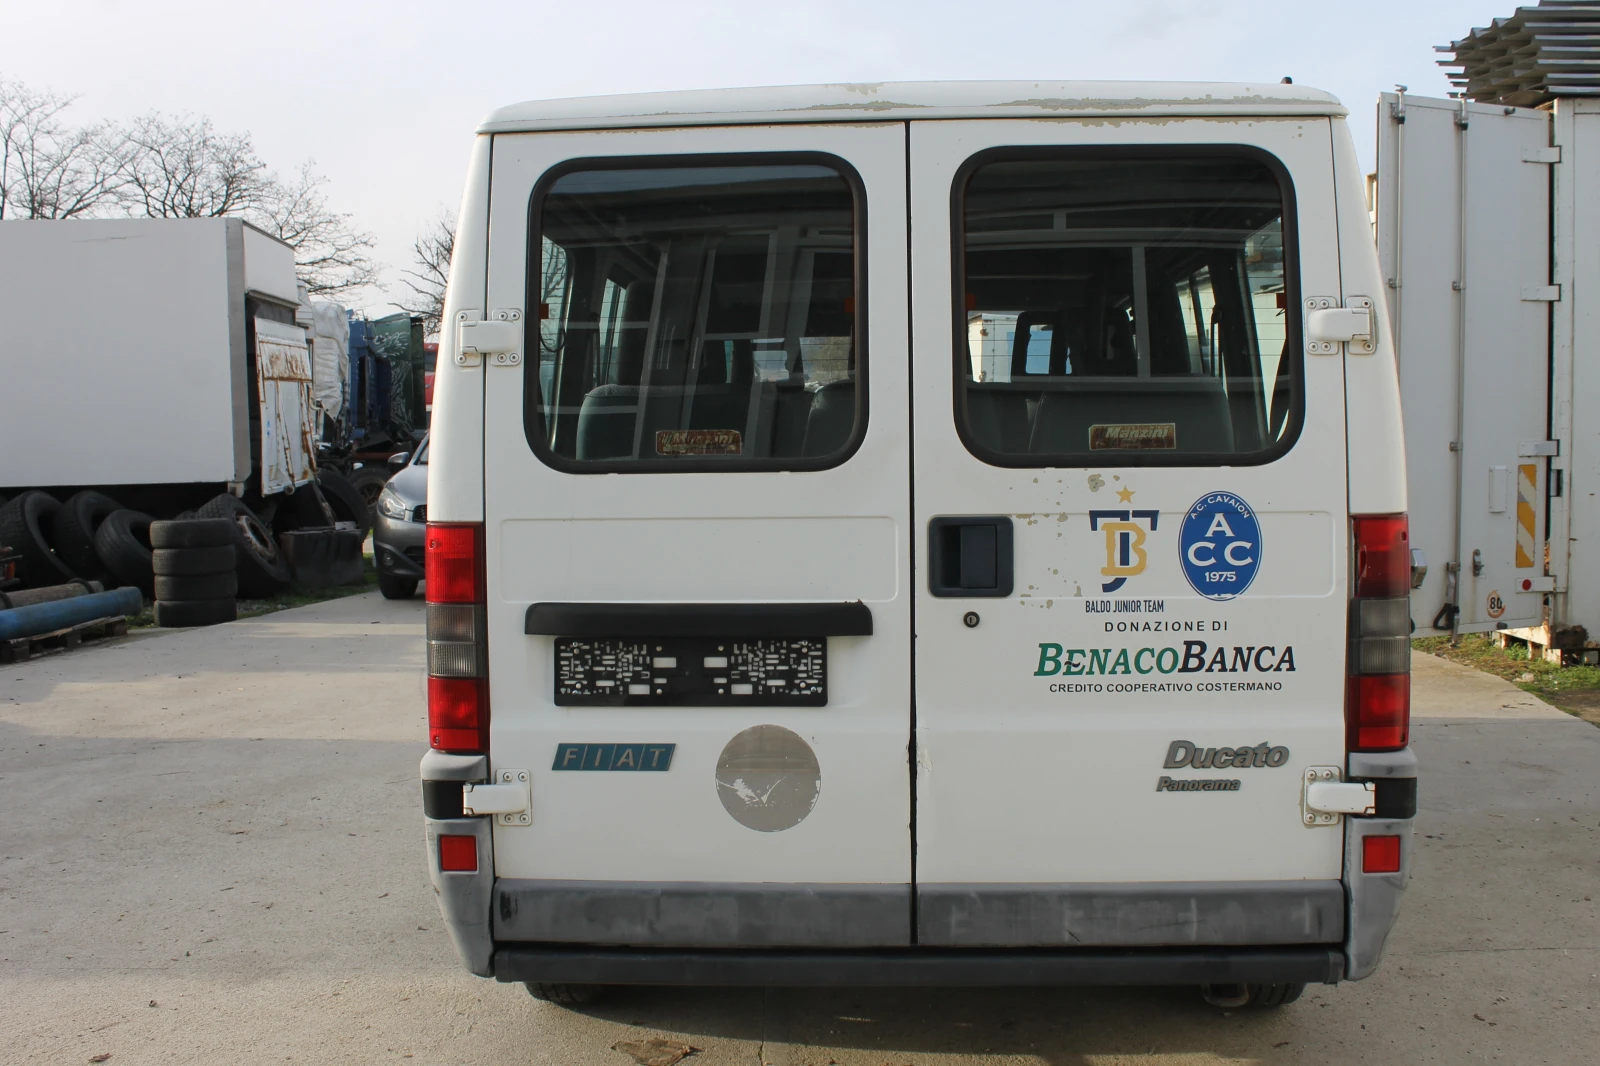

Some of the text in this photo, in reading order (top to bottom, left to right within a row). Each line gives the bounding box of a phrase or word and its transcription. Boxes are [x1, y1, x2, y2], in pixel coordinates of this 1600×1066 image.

[1105, 426, 1169, 438] Manzini
[1190, 495, 1250, 520] A.C. CAVAION
[1204, 571, 1237, 583] 1975
[1085, 599, 1164, 614] BALDO JUNIOR TEAM
[1490, 597, 1503, 609] 80
[1104, 620, 1228, 633] DONAZIONE DI
[1049, 682, 1282, 693] CREDITO COOPERATIVO COSTERMANO
[562, 749, 665, 767] FIAT
[1163, 739, 1290, 769] Ducato
[1156, 776, 1242, 792] Panorama
